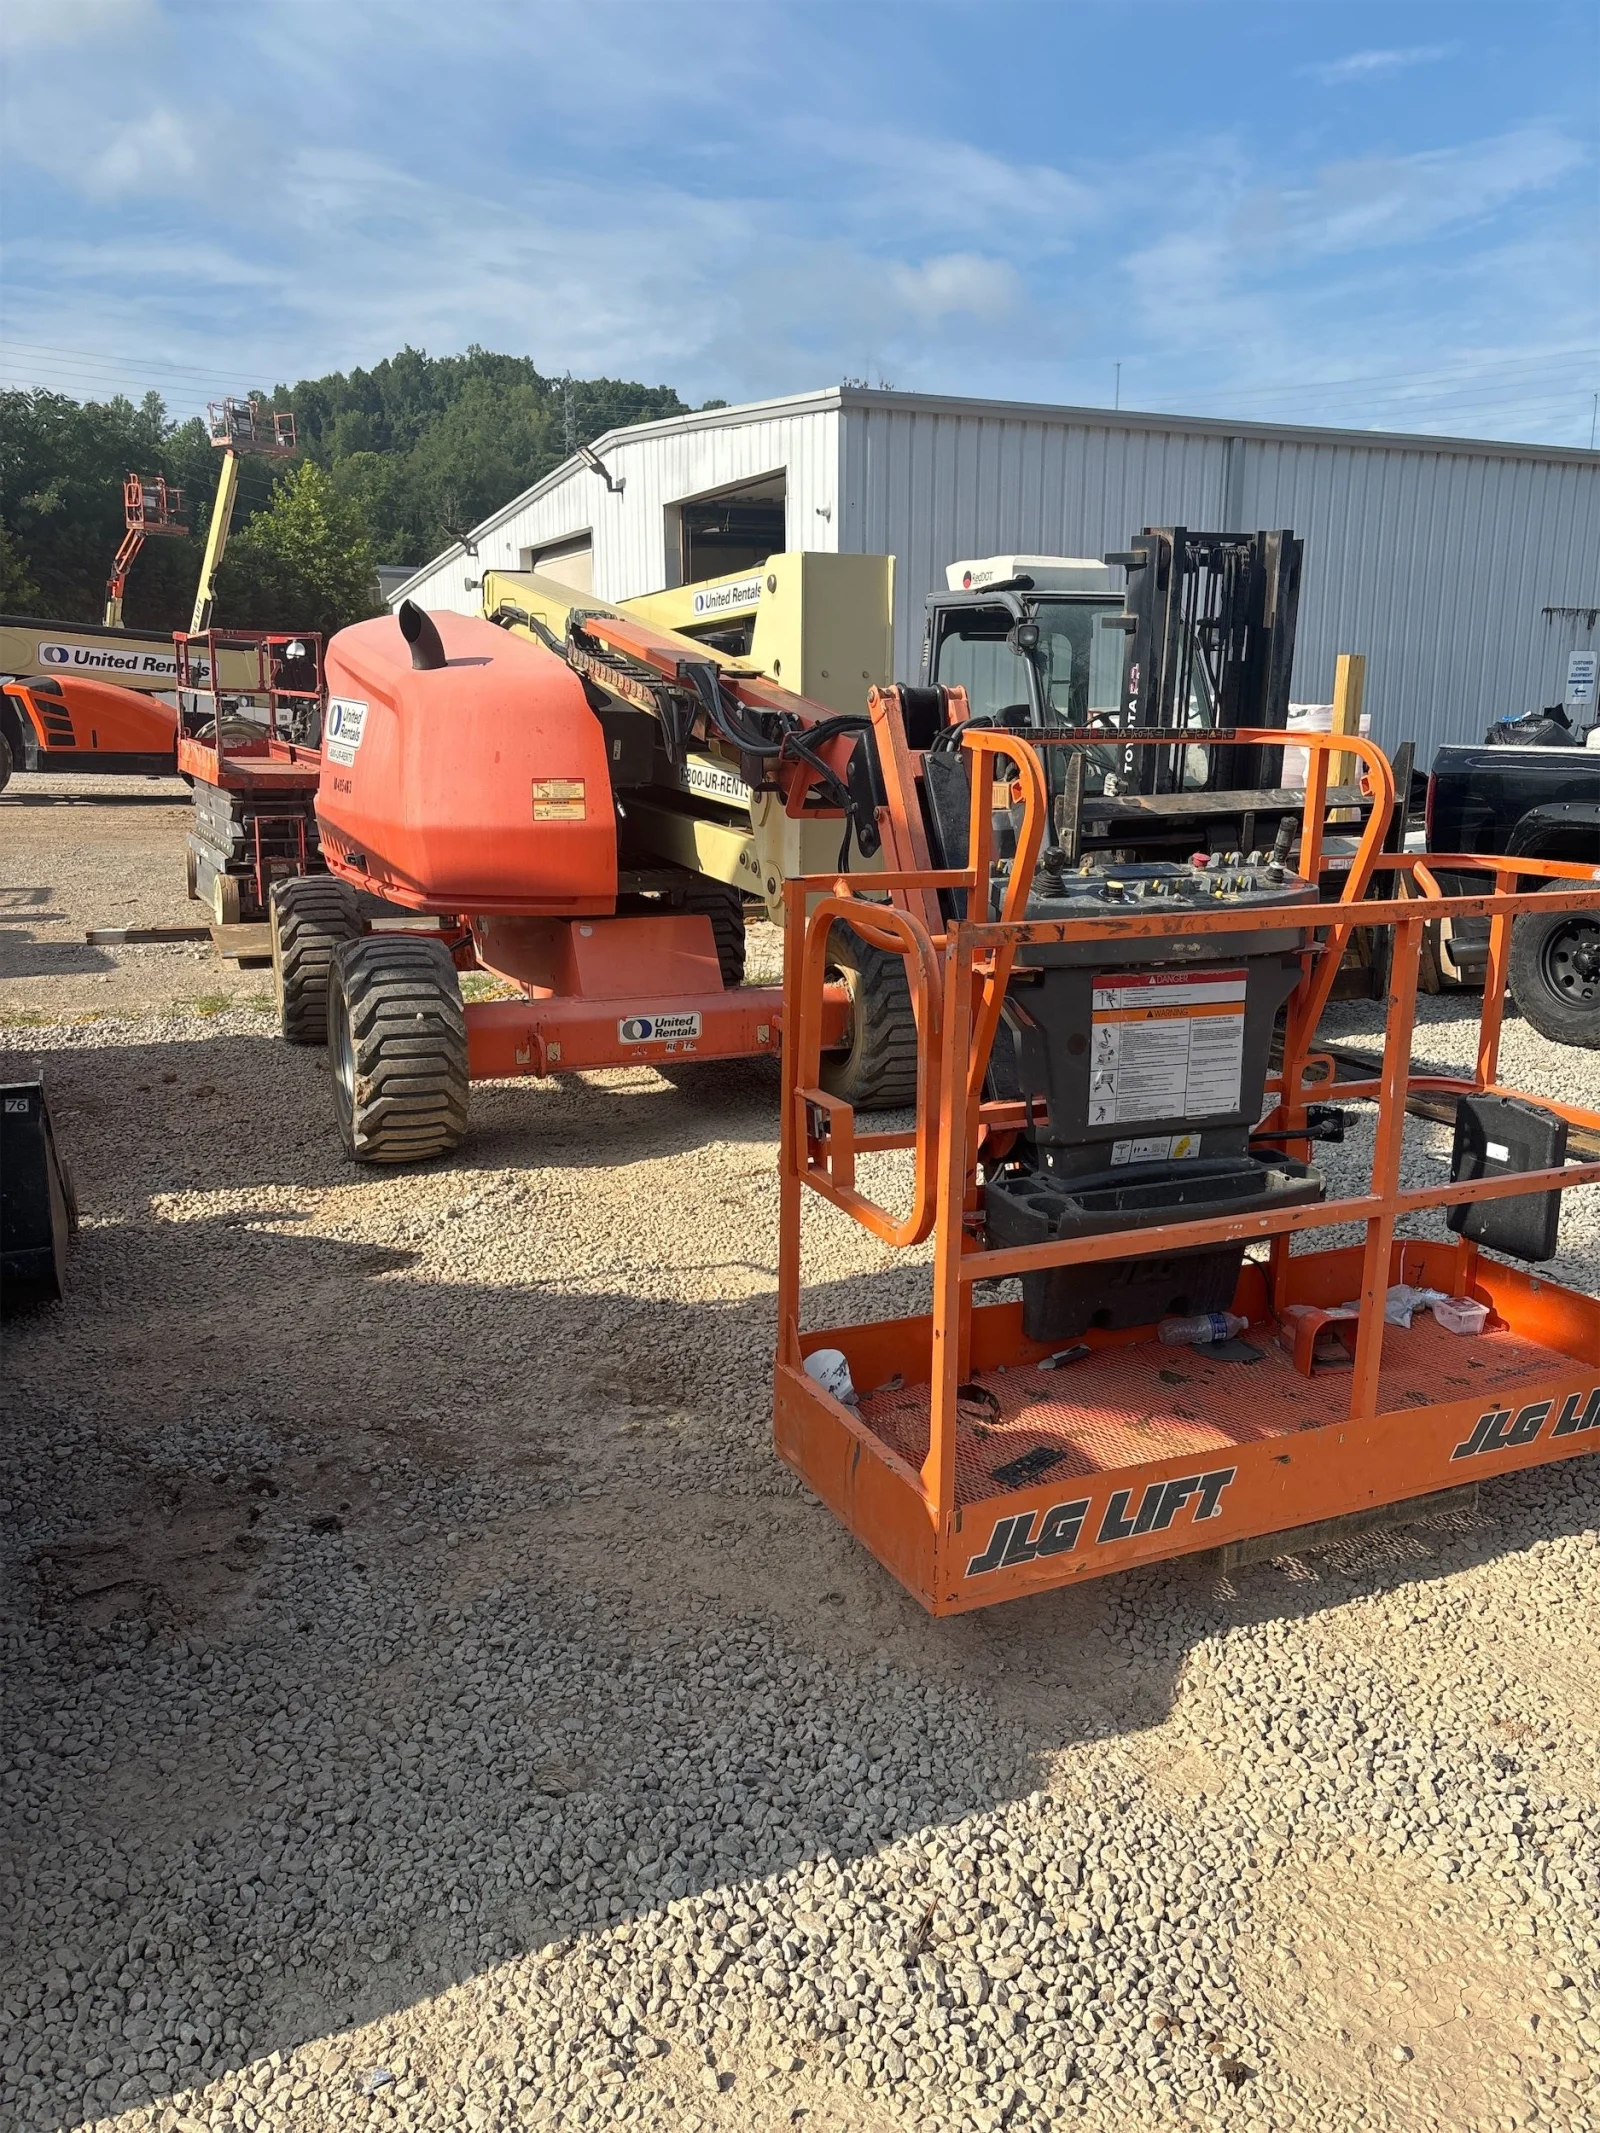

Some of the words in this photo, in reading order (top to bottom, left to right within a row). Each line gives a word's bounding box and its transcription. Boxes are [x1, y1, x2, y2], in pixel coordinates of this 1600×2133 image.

[705, 588, 731, 609] United
[732, 582, 762, 603] Rentals
[74, 650, 138, 670] United
[342, 707, 364, 725] United
[339, 723, 361, 742] Rentals
[1156, 974, 1189, 984] DANGER
[654, 1015, 695, 1028] United
[1153, 1007, 1189, 1018] WARNING
[654, 1026, 698, 1038] Rentals
[6, 1100, 26, 1111] 76
[1449, 1398, 1555, 1462] JLG
[964, 1496, 1093, 1579] JLG
[1095, 1466, 1238, 1544] LIFT
